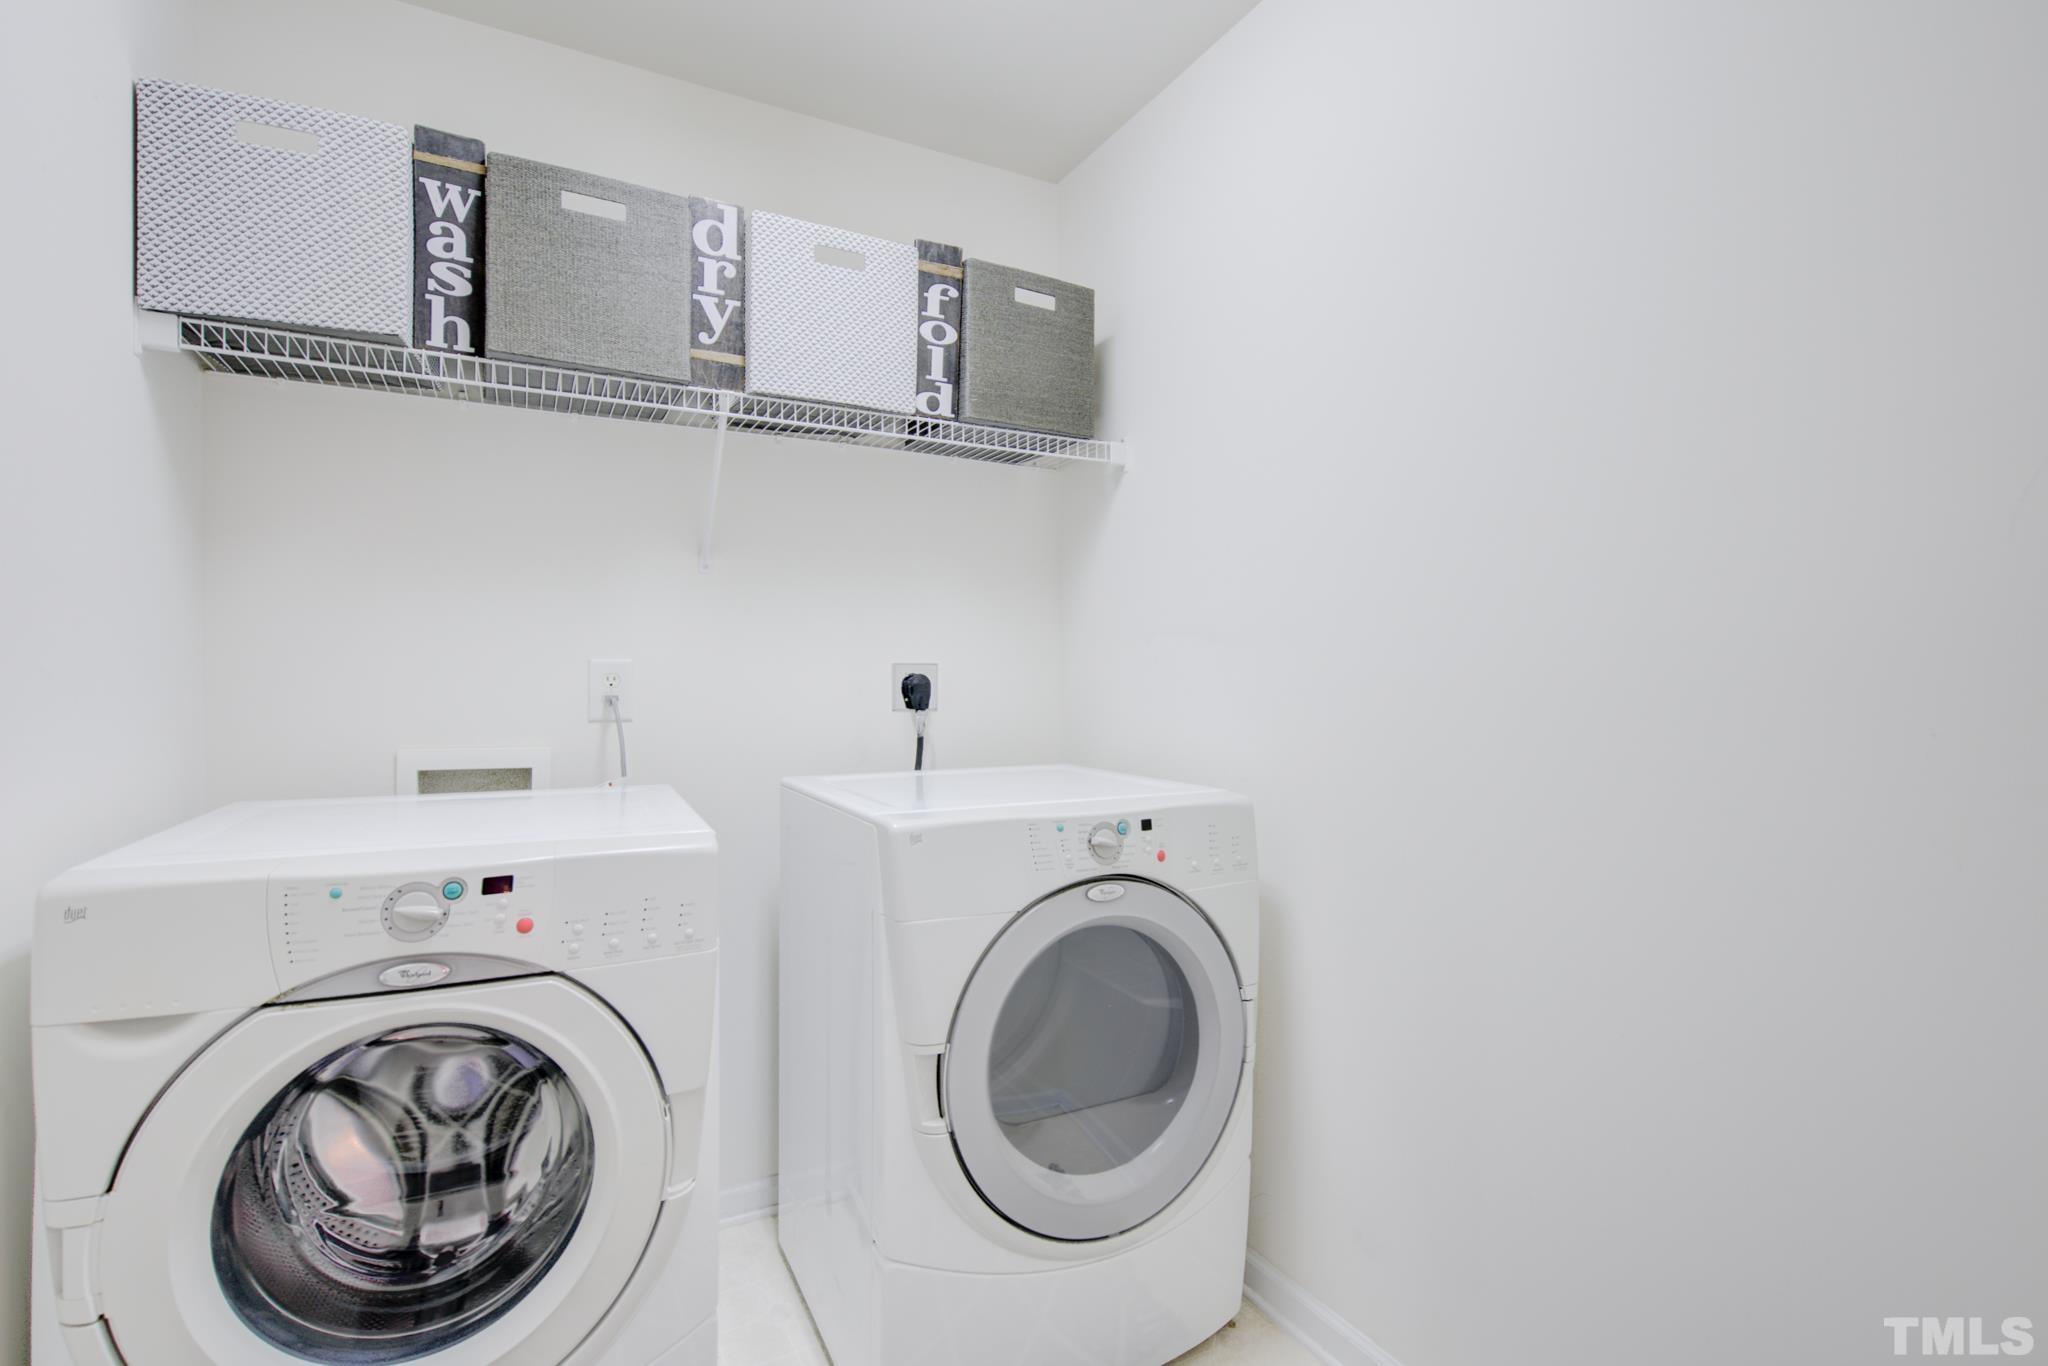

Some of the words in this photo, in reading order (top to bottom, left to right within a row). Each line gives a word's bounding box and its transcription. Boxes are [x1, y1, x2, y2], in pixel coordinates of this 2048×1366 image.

[418, 176, 482, 353] wash
[692, 203, 742, 345] dry
[916, 283, 959, 418] fold
